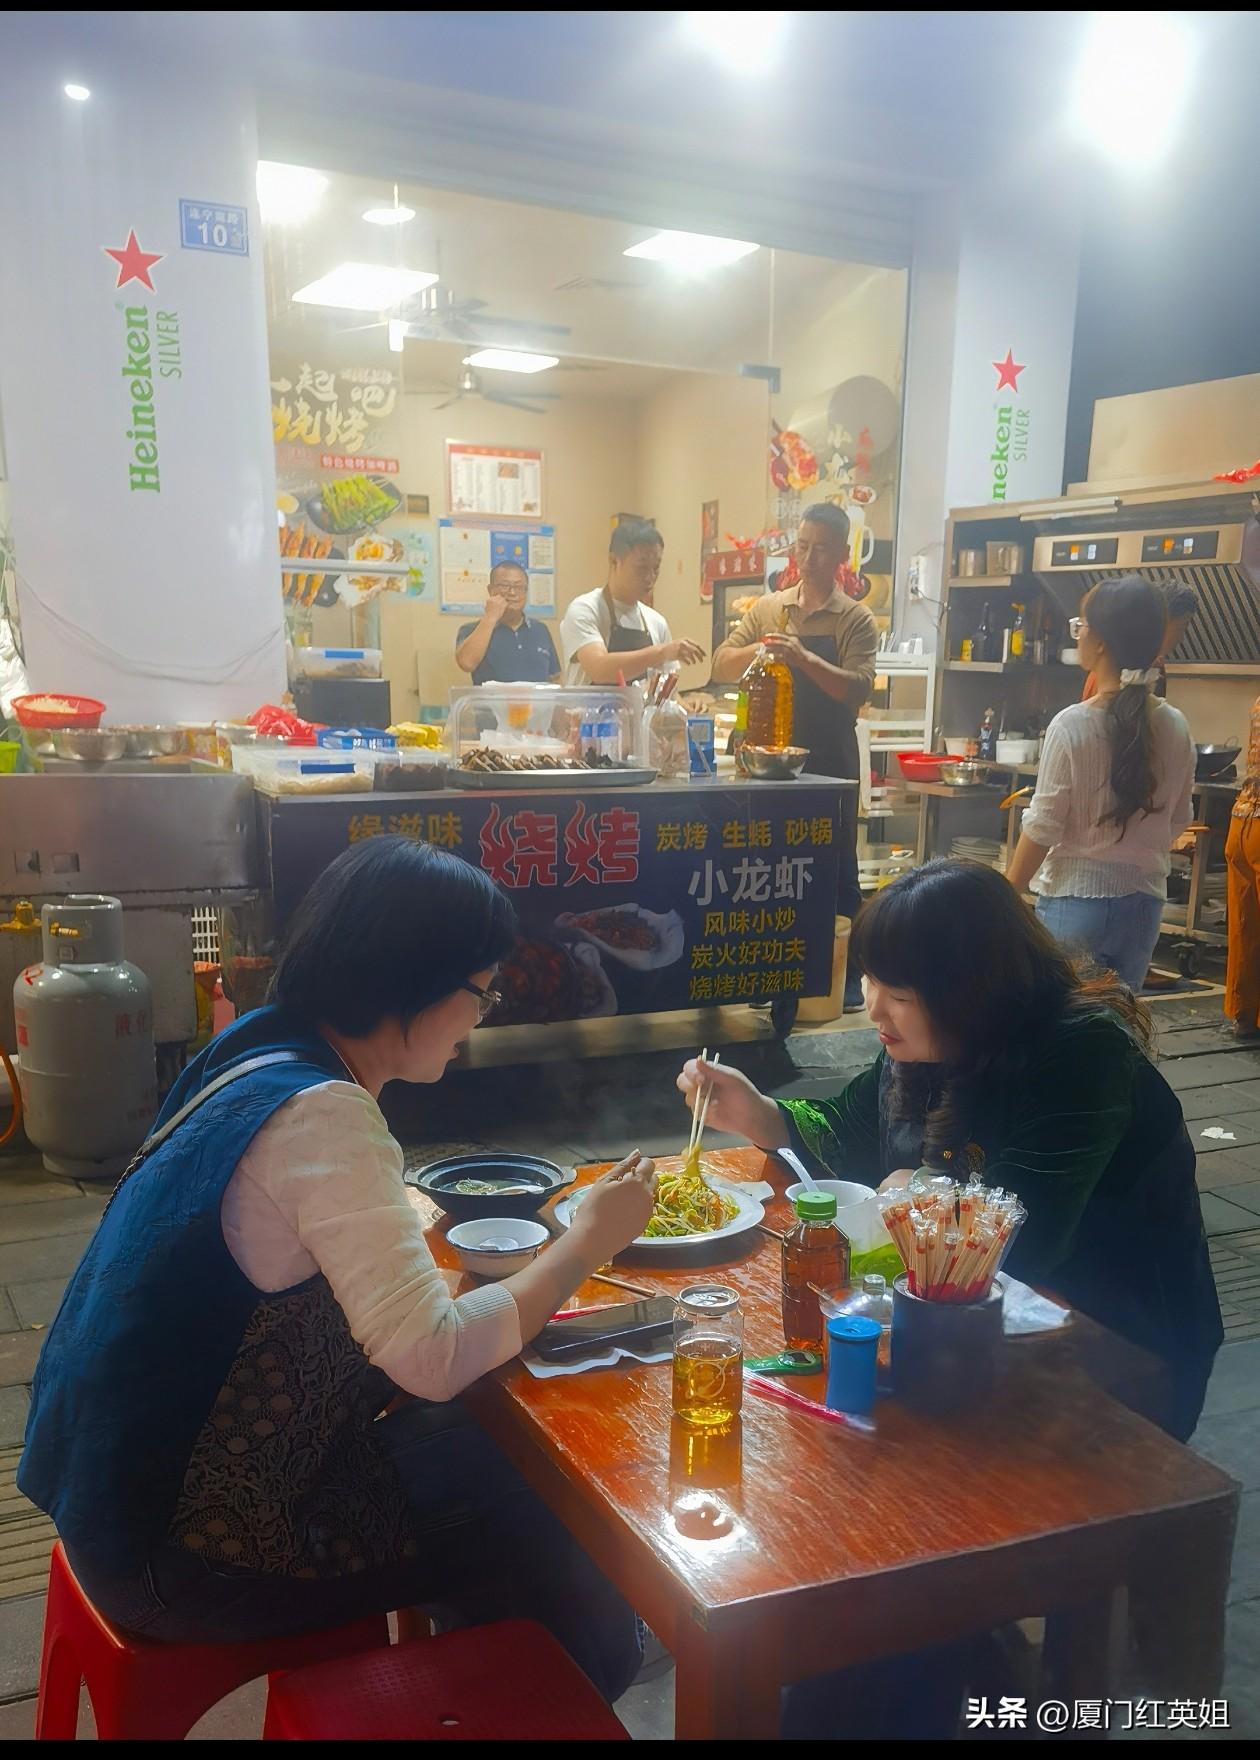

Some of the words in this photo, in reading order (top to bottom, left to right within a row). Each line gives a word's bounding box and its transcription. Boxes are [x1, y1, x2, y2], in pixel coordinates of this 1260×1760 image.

[197, 222, 227, 247] 10
[156, 311, 182, 379] SILVER
[122, 305, 161, 493] Heineken
[991, 405, 1012, 500] neken
[1013, 409, 1031, 462] SILVER
[348, 811, 463, 849] 缘滋味
[478, 801, 641, 888] 烧烤
[656, 822, 709, 852] 炭烤
[721, 819, 773, 849] 生蚝
[785, 817, 834, 846] 砂锅
[687, 855, 814, 906] 小龙虾
[704, 905, 796, 937] 风味小炒
[690, 938, 807, 970] 炭火好功夫
[689, 967, 805, 1001] 烧烤好滋味
